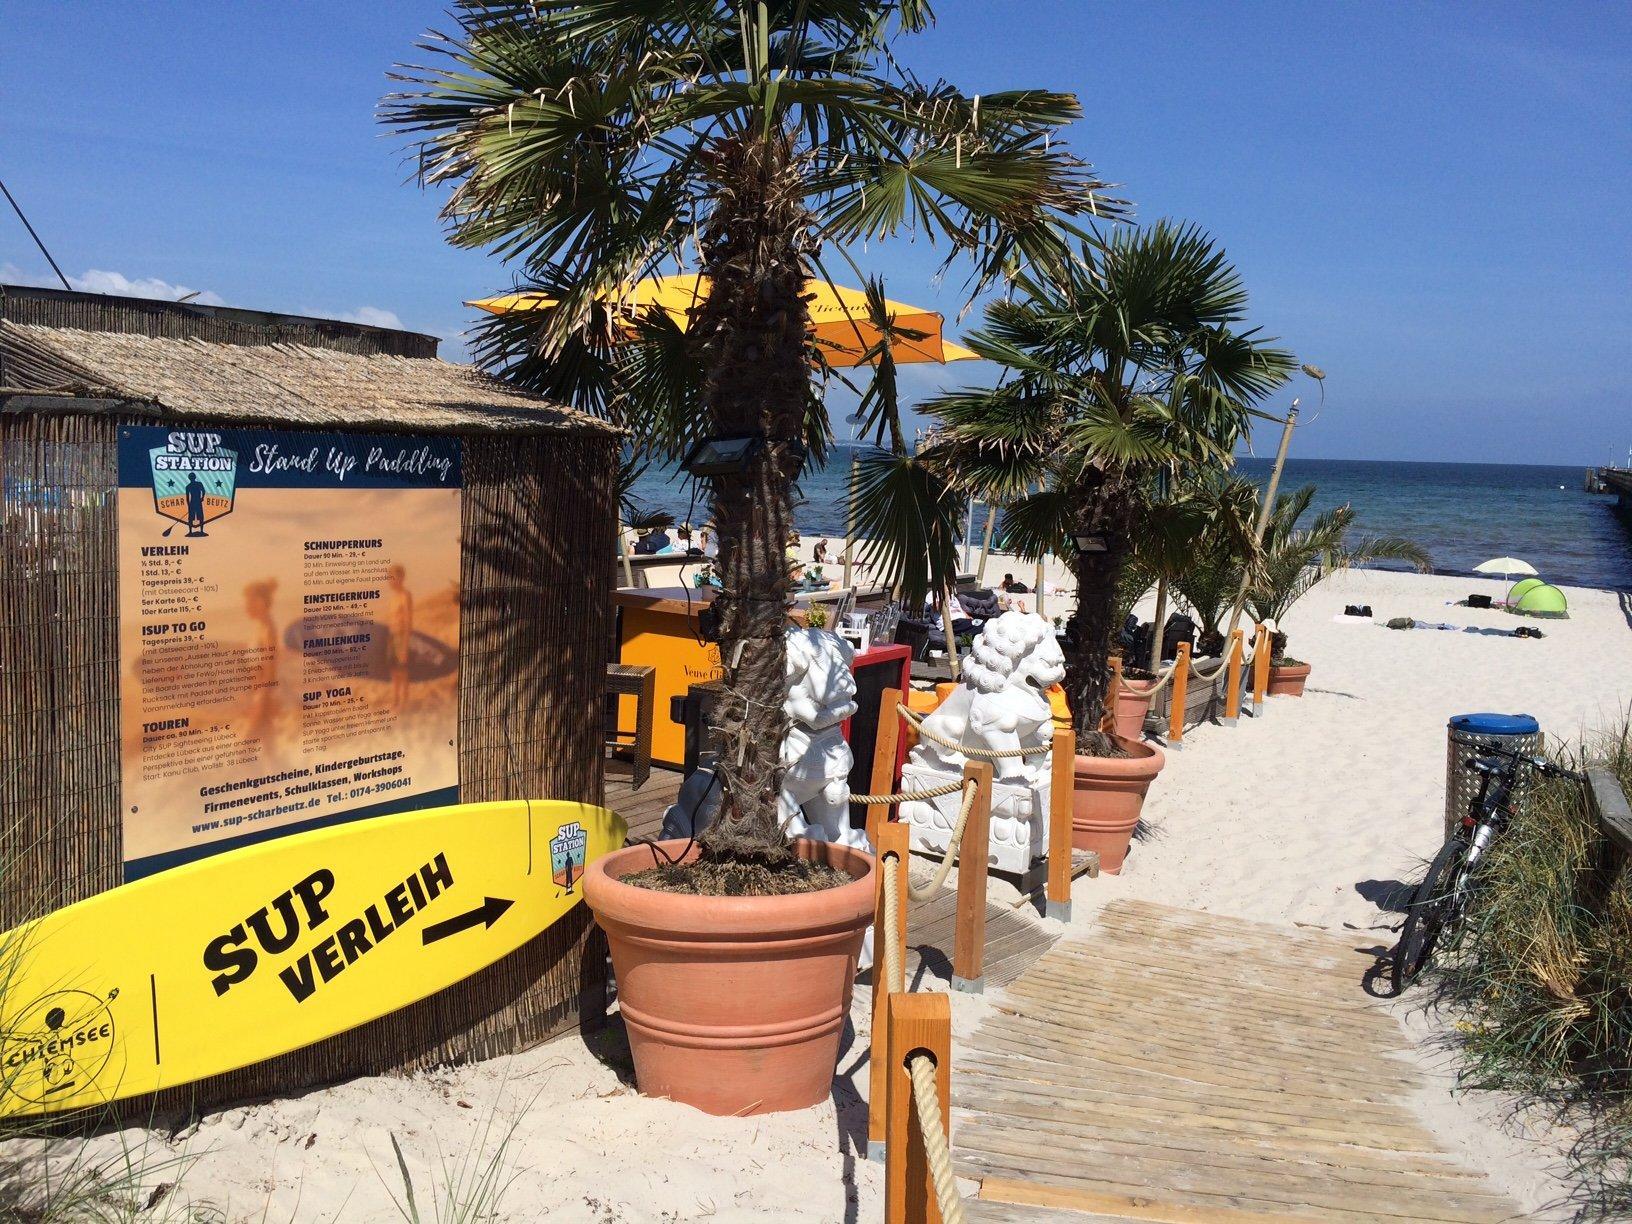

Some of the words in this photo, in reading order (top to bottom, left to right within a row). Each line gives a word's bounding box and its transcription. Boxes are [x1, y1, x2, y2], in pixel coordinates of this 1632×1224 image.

[167, 432, 221, 453] SUP
[156, 456, 232, 470] STATION
[250, 444, 319, 474] Stand
[326, 446, 358, 481] Up
[365, 446, 453, 481] Paddling
[160, 498, 185, 508] SCHAR
[206, 498, 229, 508] BEUTZ
[141, 546, 189, 556] VERLEIH
[304, 539, 382, 551] SCHNUPPERKURS
[142, 579, 182, 588] Tagespreis
[304, 590, 380, 604] EINSTEIGERKURS
[142, 624, 169, 635] ISUP
[172, 623, 186, 632] TO
[190, 621, 206, 631] GO
[142, 636, 182, 646] Tagespreis
[304, 634, 370, 649] FAMILIENKURS
[684, 665, 708, 678] Veuve
[303, 691, 321, 702] SUP
[326, 687, 351, 698] YOGA
[142, 718, 189, 733] TOUREN
[143, 735, 165, 743] Dauer
[200, 768, 313, 797] Geschenkgutscheine,
[315, 750, 405, 774] Kindergeburtstage,
[204, 790, 283, 813] Firmenevents,
[284, 776, 351, 796] Schulklassen,
[353, 765, 403, 782] Workshops
[192, 798, 321, 833] www.sup-scharbeutz.de
[327, 792, 348, 804] Tel.:
[350, 777, 412, 799] 0174-3906041
[558, 822, 580, 841] SUP
[553, 837, 584, 854] STATION
[203, 868, 335, 997] SUP
[278, 851, 454, 1004] VERLEIH
[7, 1023, 110, 1067] CHIEMSEE
